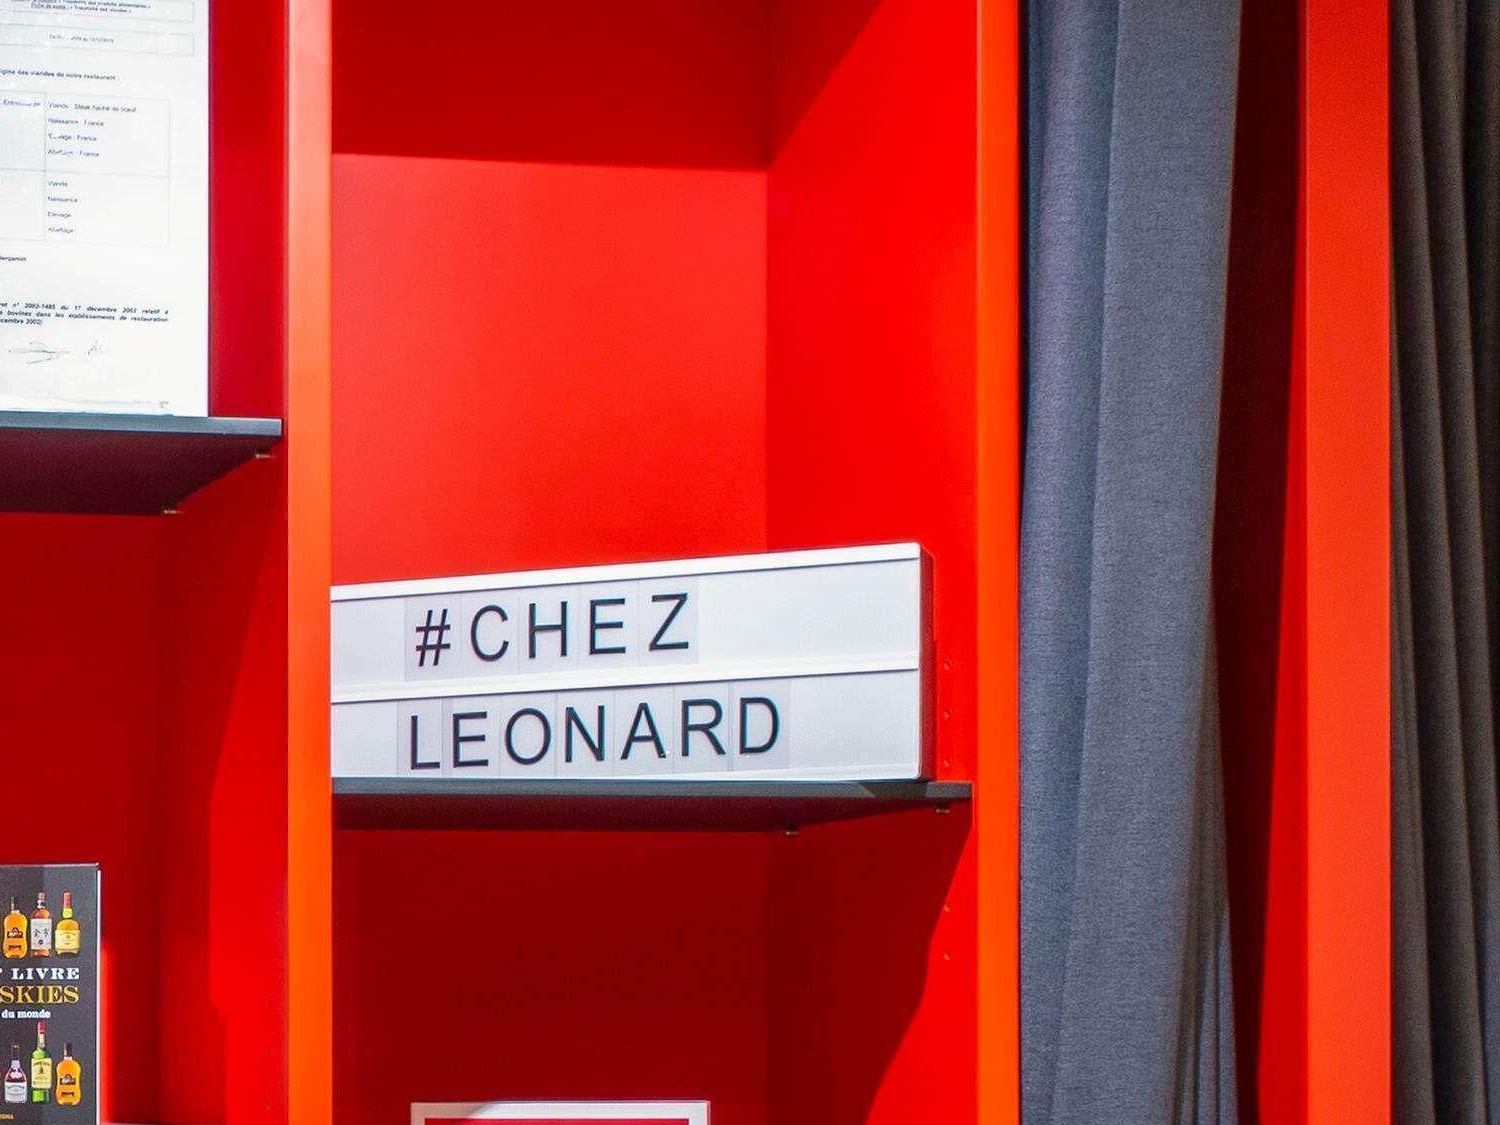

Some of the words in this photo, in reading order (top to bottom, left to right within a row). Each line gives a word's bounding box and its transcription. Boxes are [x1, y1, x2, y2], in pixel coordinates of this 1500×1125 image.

[7, 309, 32, 317] bovines
[410, 696, 781, 771] LEONARD
[11, 967, 80, 981] LIVRE
[1, 1009, 16, 1019] du
[17, 1009, 51, 1019] monde
